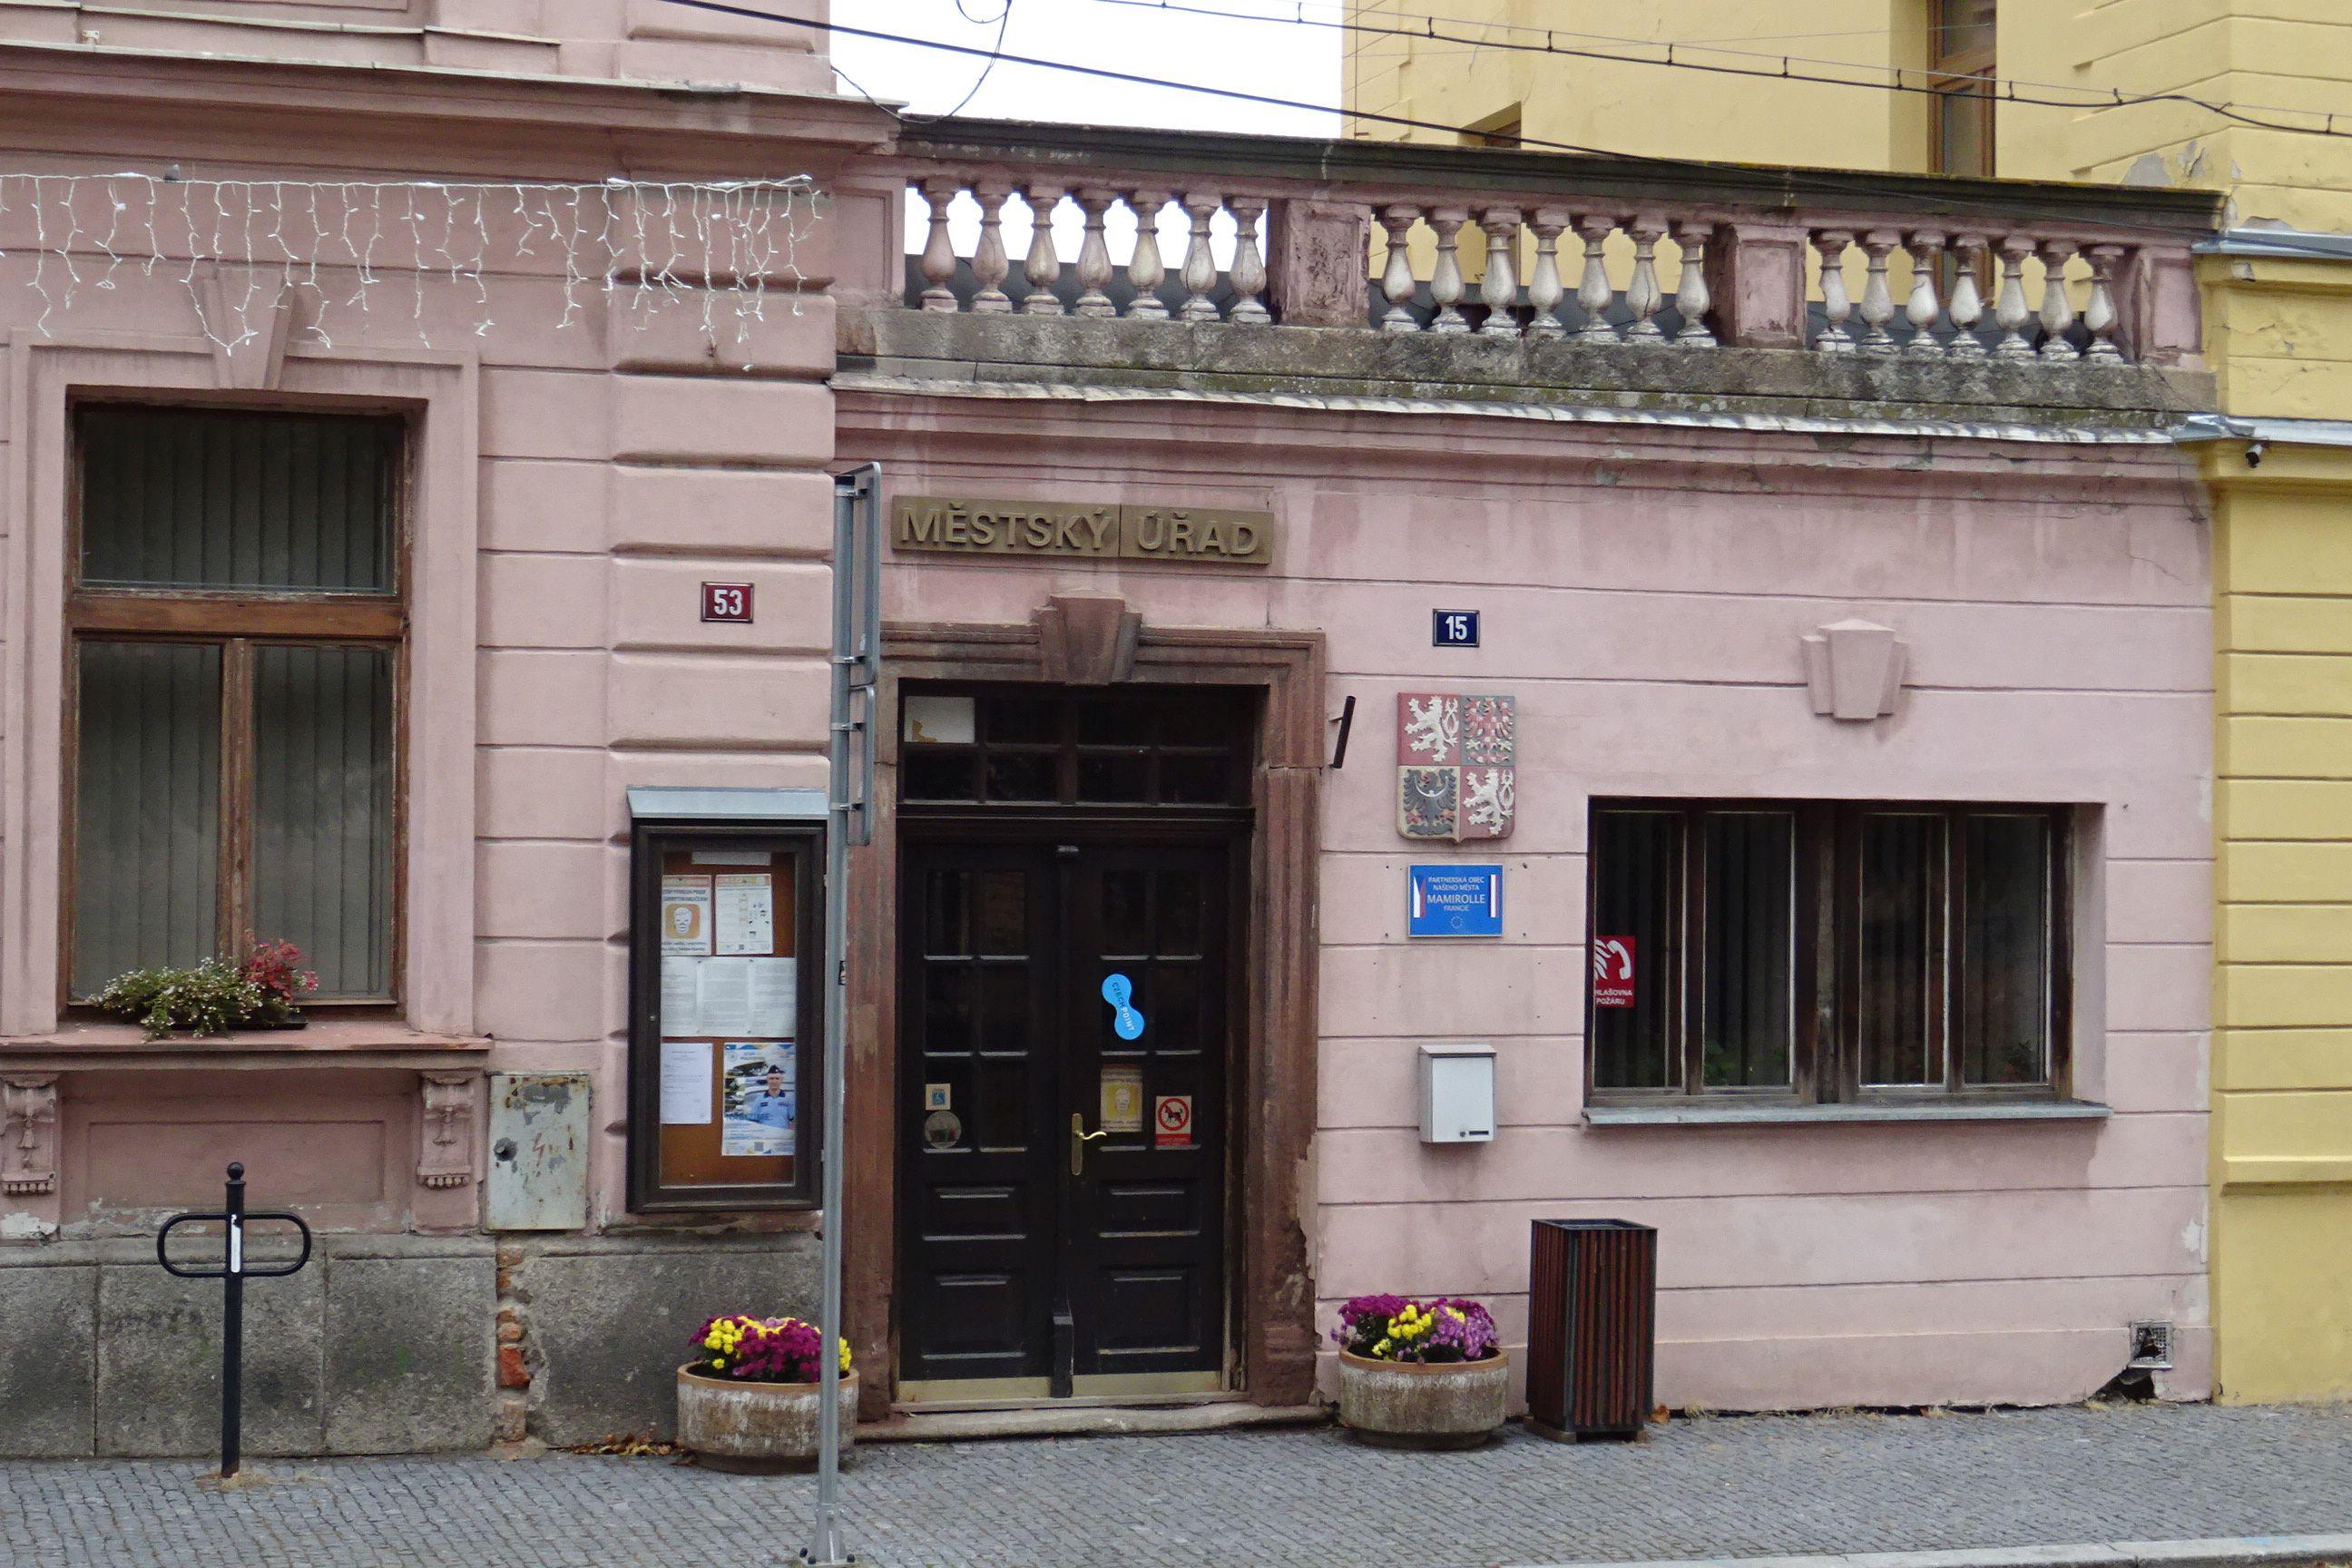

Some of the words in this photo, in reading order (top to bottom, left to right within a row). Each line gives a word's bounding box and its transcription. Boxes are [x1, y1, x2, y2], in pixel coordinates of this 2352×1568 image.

[900, 502, 1112, 550] MĚSTSKÝ
[1136, 510, 1259, 556] ÚŘAD
[713, 589, 743, 616] 53
[1445, 615, 1468, 641] 15
[1427, 876, 1467, 884] PARTNERSKÁ
[1433, 883, 1458, 891] NAŠEHO
[1459, 883, 1480, 891] MĚSTA
[1426, 894, 1485, 904] MAMIROLLE
[1112, 982, 1126, 1008] CZECH
[1121, 1006, 1135, 1031] POINT
[1596, 996, 1625, 1004] POŽÁRU
